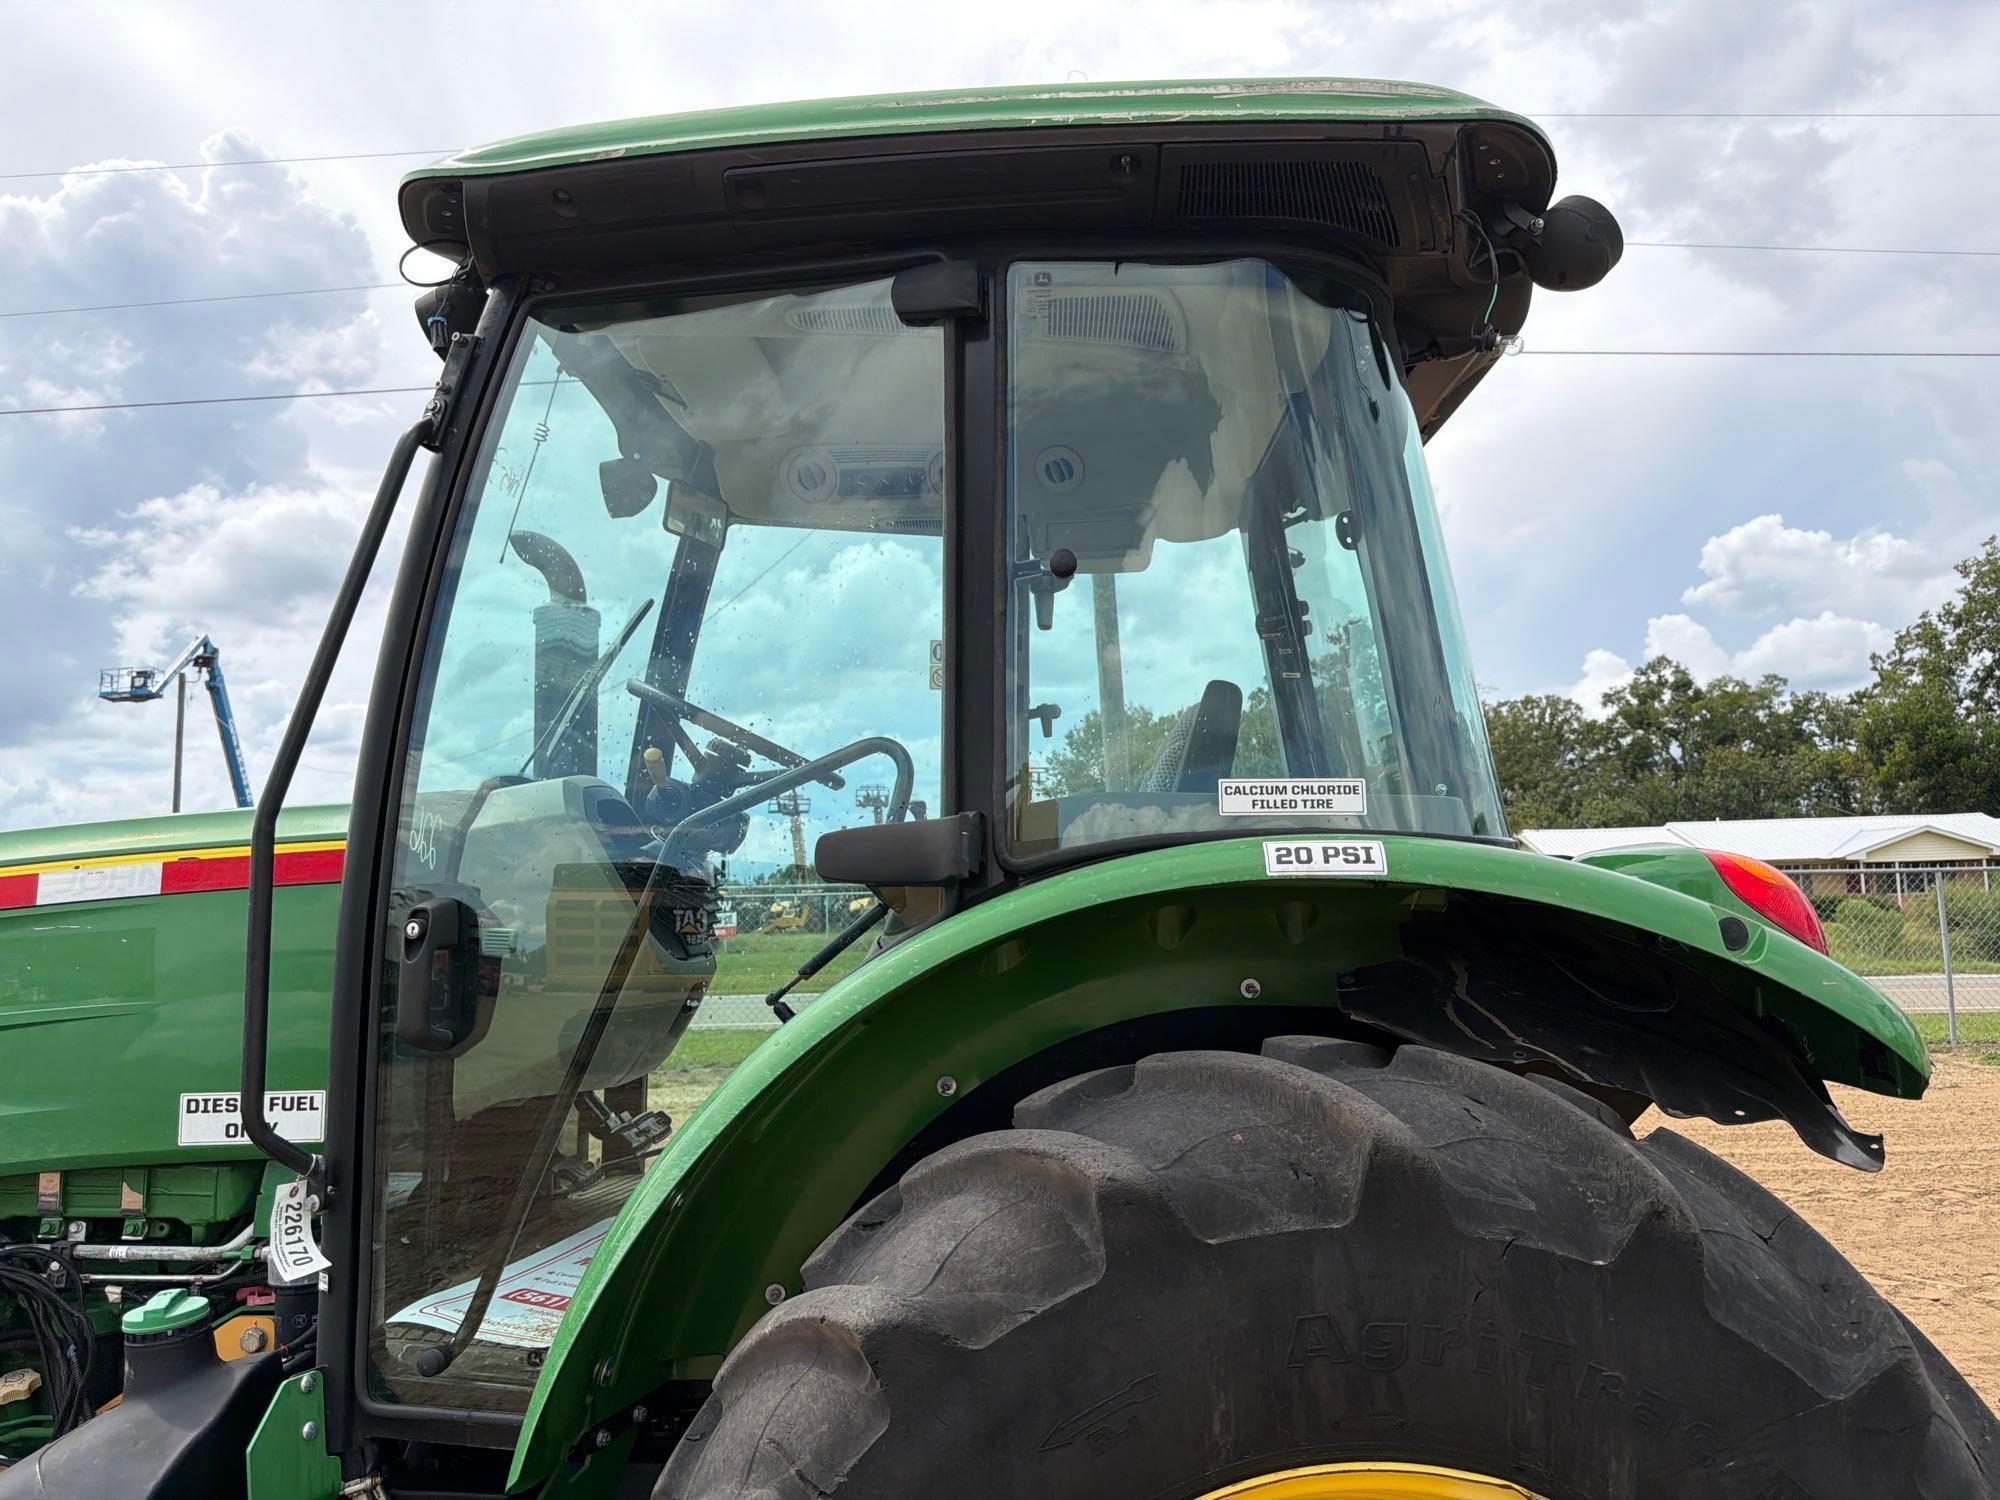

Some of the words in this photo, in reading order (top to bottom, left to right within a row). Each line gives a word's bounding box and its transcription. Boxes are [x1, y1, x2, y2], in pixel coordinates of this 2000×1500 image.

[1224, 784, 1288, 796] CALCIUM
[1291, 784, 1360, 796] CHLORIDE
[1252, 798, 1297, 810] FILLED
[1301, 798, 1334, 810] TIRE
[1275, 846, 1313, 865] 20
[1323, 846, 1376, 865] PSI
[186, 1097, 240, 1114] DIES
[269, 1095, 320, 1112] FUEL
[284, 1201, 314, 1267] 226170
[507, 1289, 570, 1308] (561)
